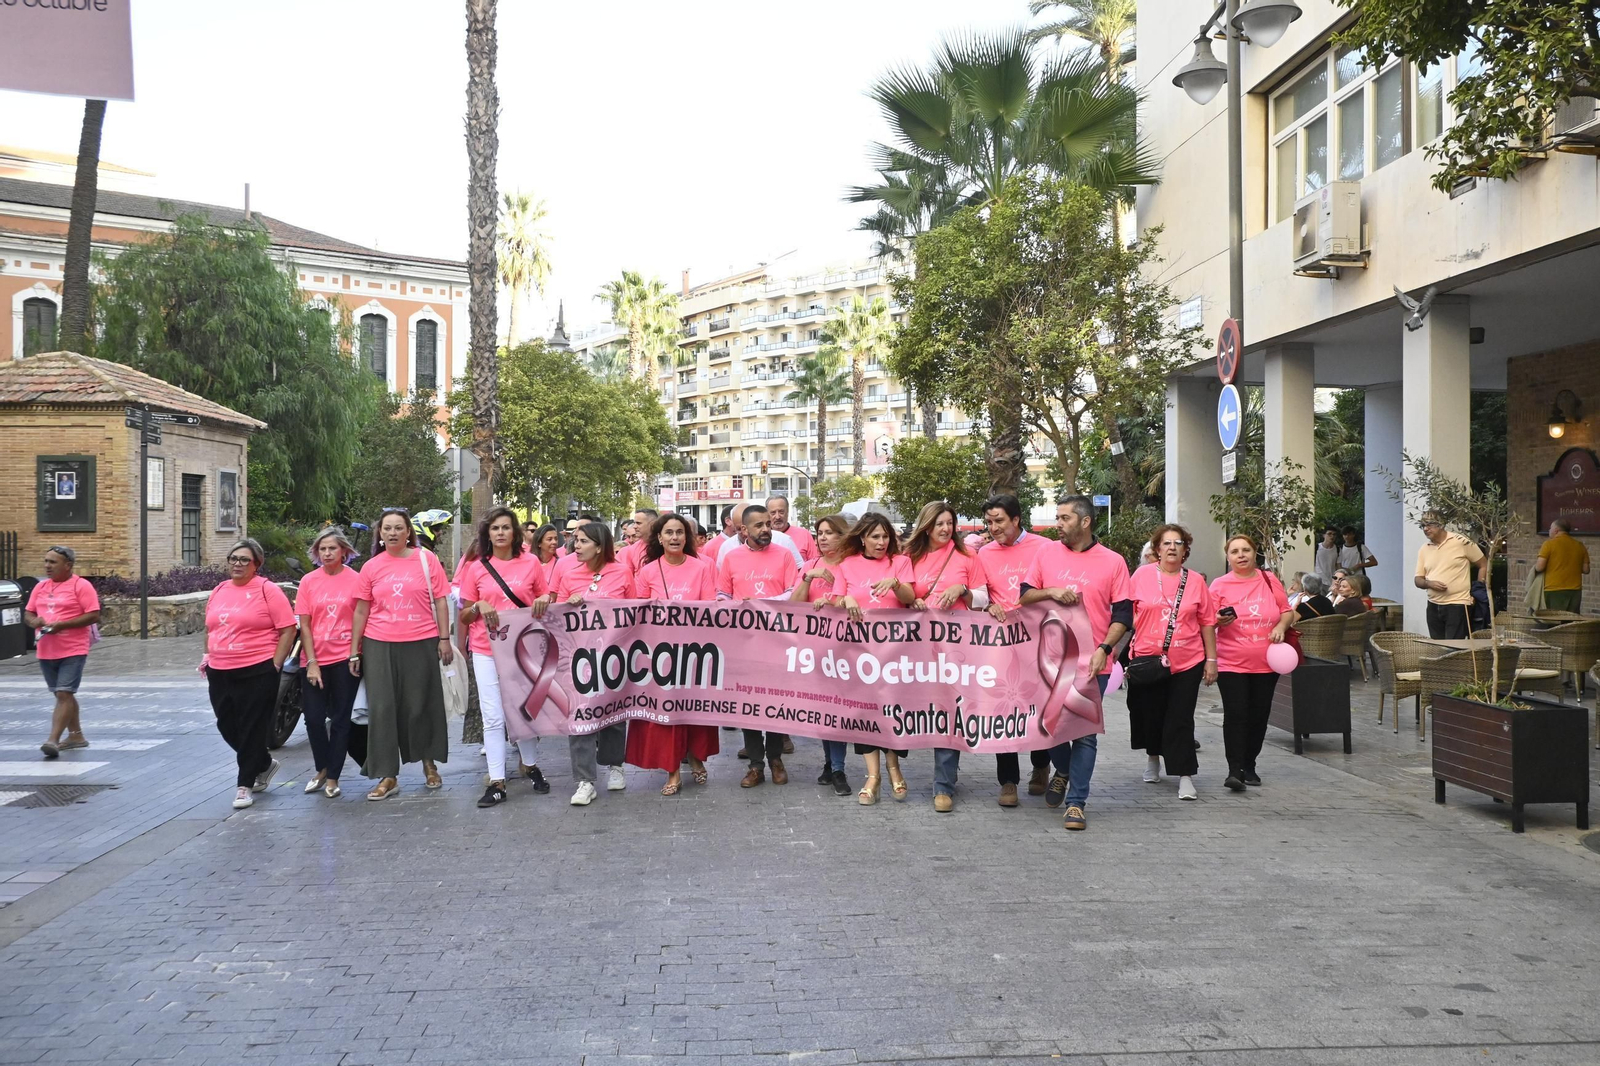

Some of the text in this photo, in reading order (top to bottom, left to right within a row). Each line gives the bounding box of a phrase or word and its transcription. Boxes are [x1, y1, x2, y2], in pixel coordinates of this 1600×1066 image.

[563, 604, 1032, 647] DÍA INTERNACIONAL DEL CÁNCER DE MAMA
[572, 640, 725, 698] aocam
[785, 646, 997, 688] 19 de Octubre
[574, 692, 881, 734] ASOCIACIÓN ONUBENSE DE CÁNCER DE MAMA
[736, 683, 753, 695] hay
[754, 686, 766, 695] un
[768, 688, 795, 698] nuevo
[797, 691, 833, 703] amanecer
[833, 695, 842, 706] de
[843, 698, 879, 710] esperanza
[575, 709, 670, 733] www.aocamhuelva.es
